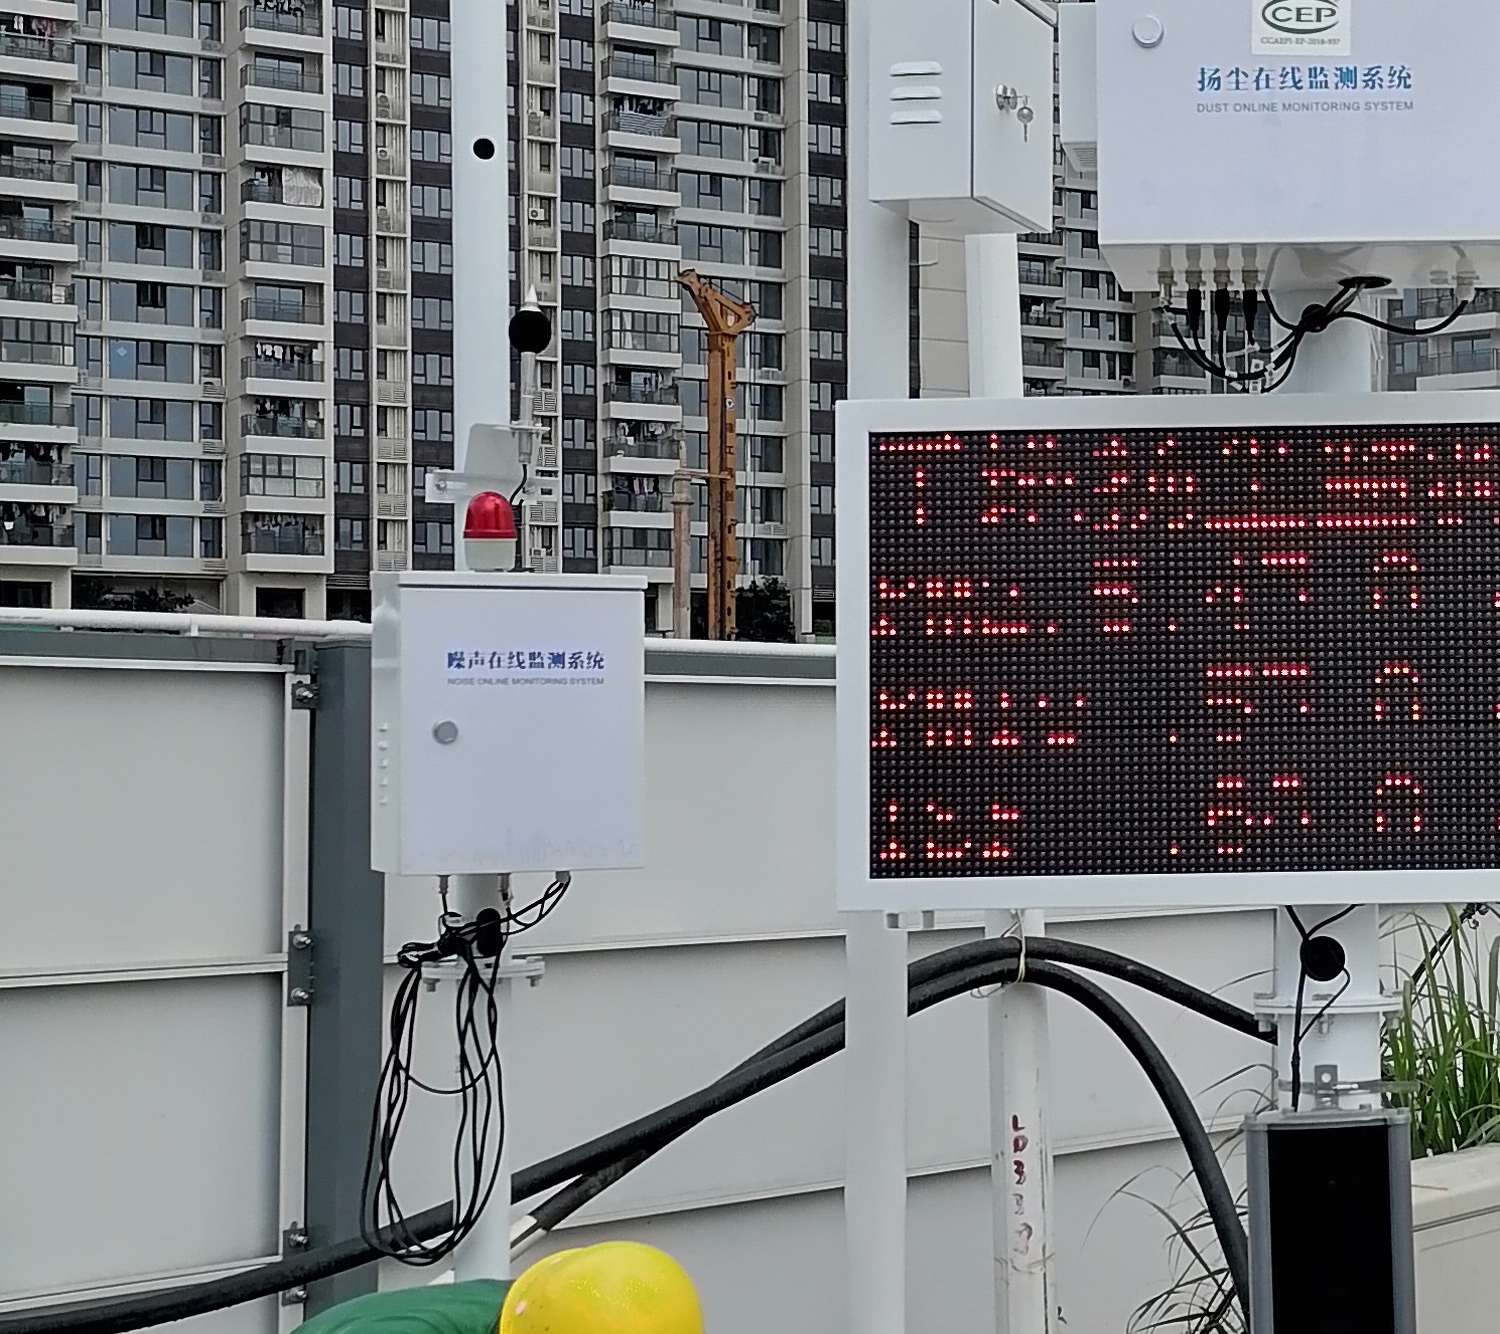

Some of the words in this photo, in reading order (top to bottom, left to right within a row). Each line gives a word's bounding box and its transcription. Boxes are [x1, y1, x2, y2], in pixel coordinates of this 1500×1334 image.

[1271, 6, 1337, 23] CEP
[1196, 64, 1413, 92] 扬尘在线监测系统
[1196, 103, 1229, 113] DUST
[1233, 102, 1278, 113] ONLINE
[1282, 101, 1361, 113] MONITORING
[1364, 101, 1414, 112] SYSTEM
[447, 650, 605, 670] 噪声在线监测系统
[447, 678, 475, 686] NOISE
[477, 678, 510, 686] ONLINE
[512, 677, 568, 686] MONITORING
[569, 677, 605, 685] SYSTEM
